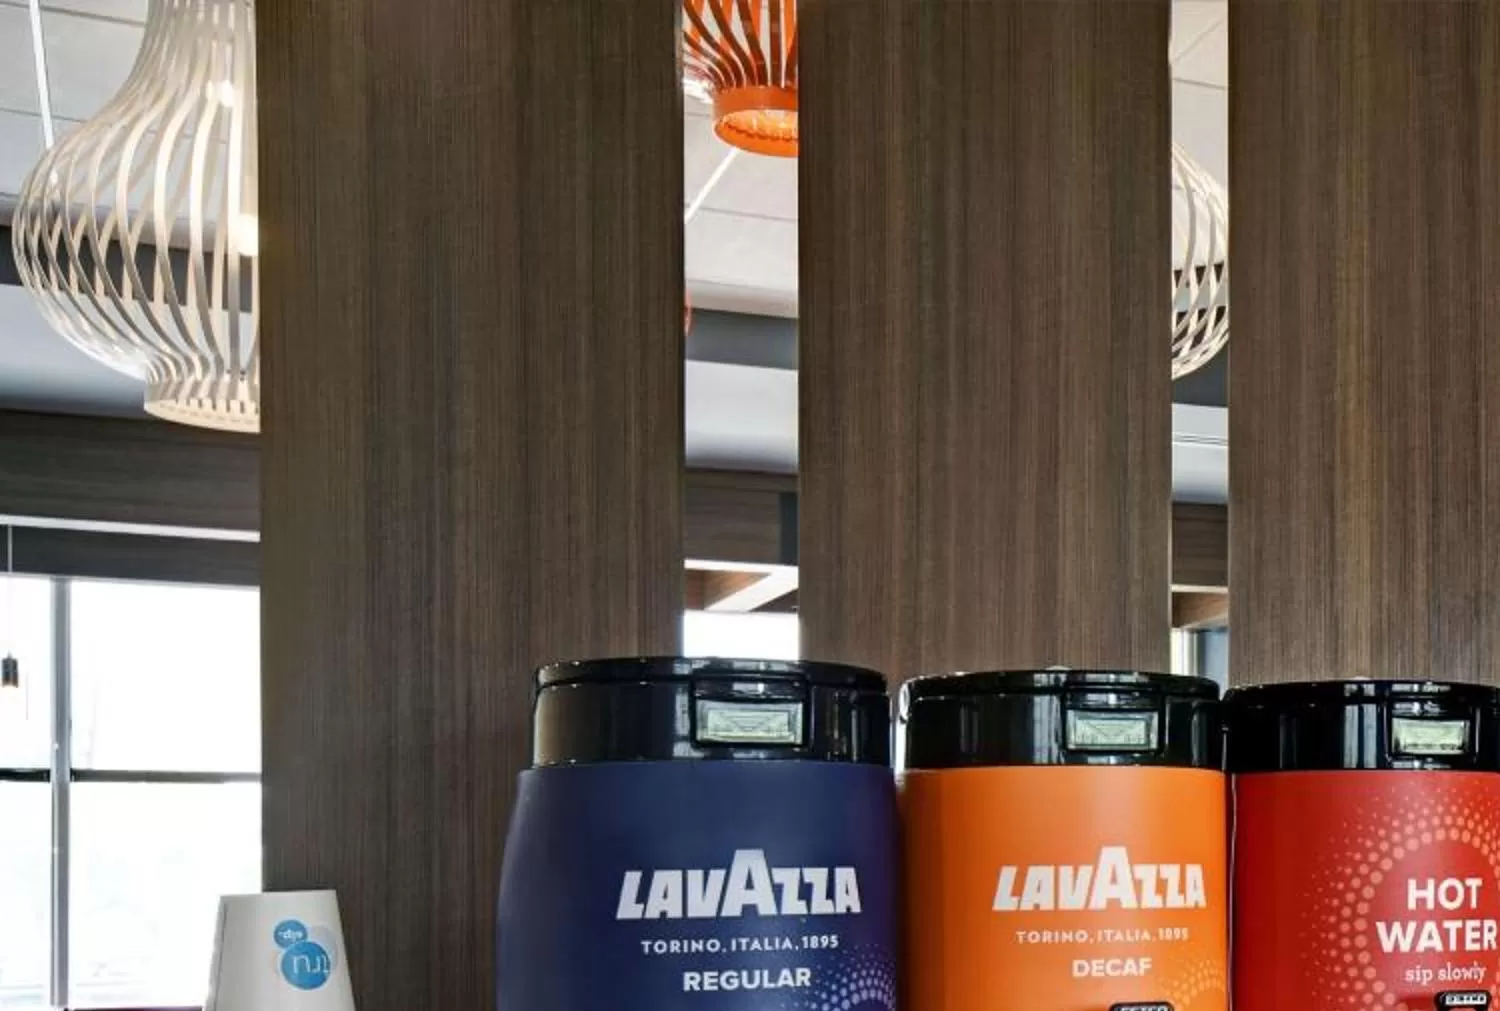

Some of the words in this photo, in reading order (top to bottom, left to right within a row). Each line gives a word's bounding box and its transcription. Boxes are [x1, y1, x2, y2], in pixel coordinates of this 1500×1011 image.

[616, 848, 862, 920] LAVAZZA
[992, 845, 1207, 911] LAVAZZA
[1407, 877, 1483, 911] HOT
[801, 935, 839, 950] 1895
[1375, 919, 1498, 953] WATER
[683, 967, 812, 992] REGULAR
[1072, 957, 1152, 978] DECAF
[1405, 965, 1433, 985] sip
[1438, 961, 1487, 984] slowly
